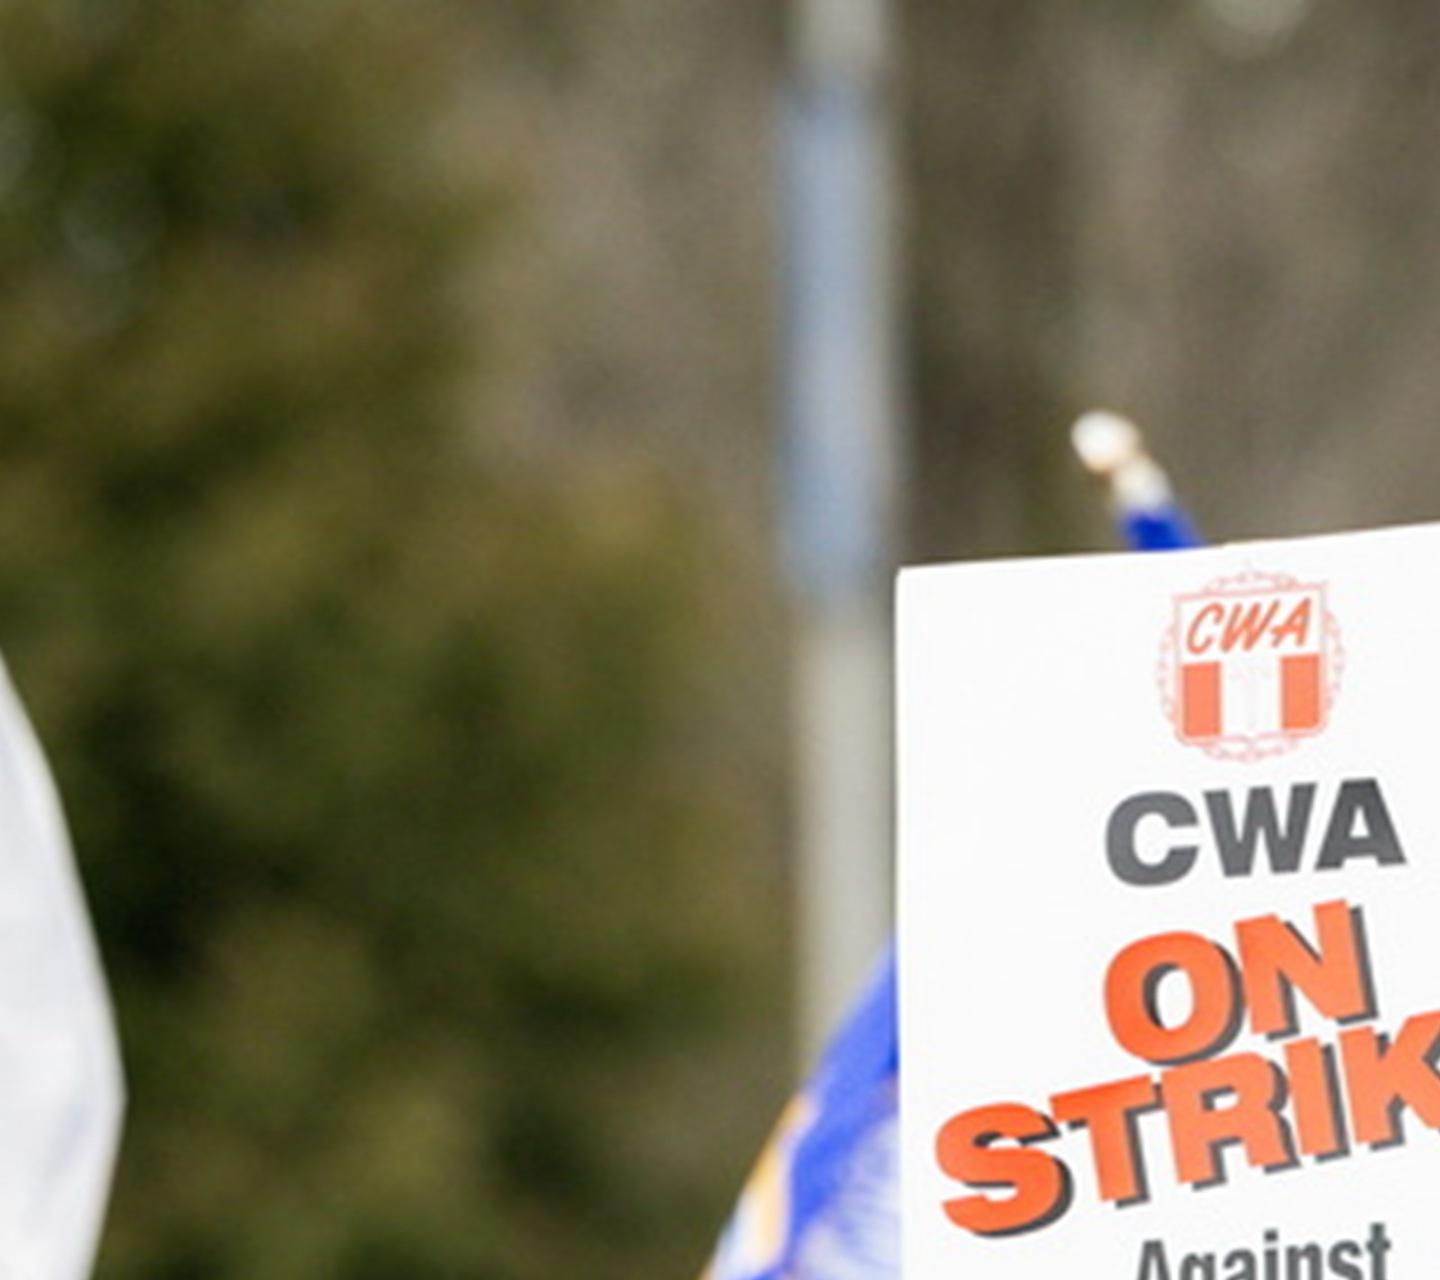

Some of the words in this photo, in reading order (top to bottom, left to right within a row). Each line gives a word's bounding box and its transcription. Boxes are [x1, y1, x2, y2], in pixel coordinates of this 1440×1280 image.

[1186, 596, 1312, 655] CWA
[1104, 778, 1407, 888] CWA
[1103, 898, 1379, 1067] ON
